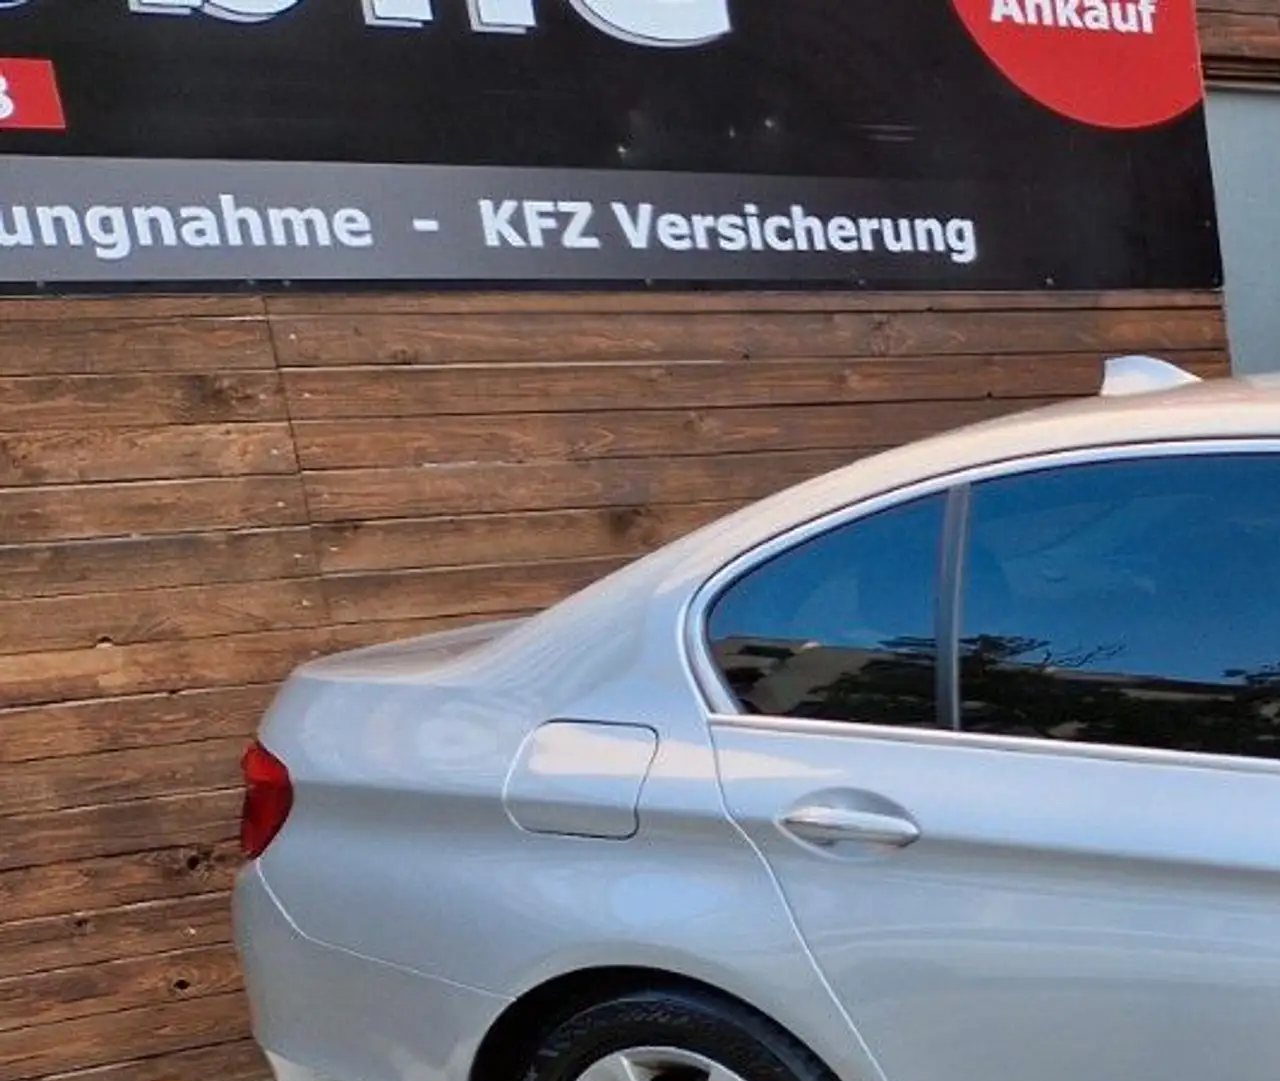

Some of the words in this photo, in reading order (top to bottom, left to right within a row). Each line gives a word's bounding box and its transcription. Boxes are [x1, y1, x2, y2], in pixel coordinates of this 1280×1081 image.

[990, 0, 1157, 34] Ankauf
[478, 199, 602, 249] KFZ
[610, 202, 977, 264] Versicherung
